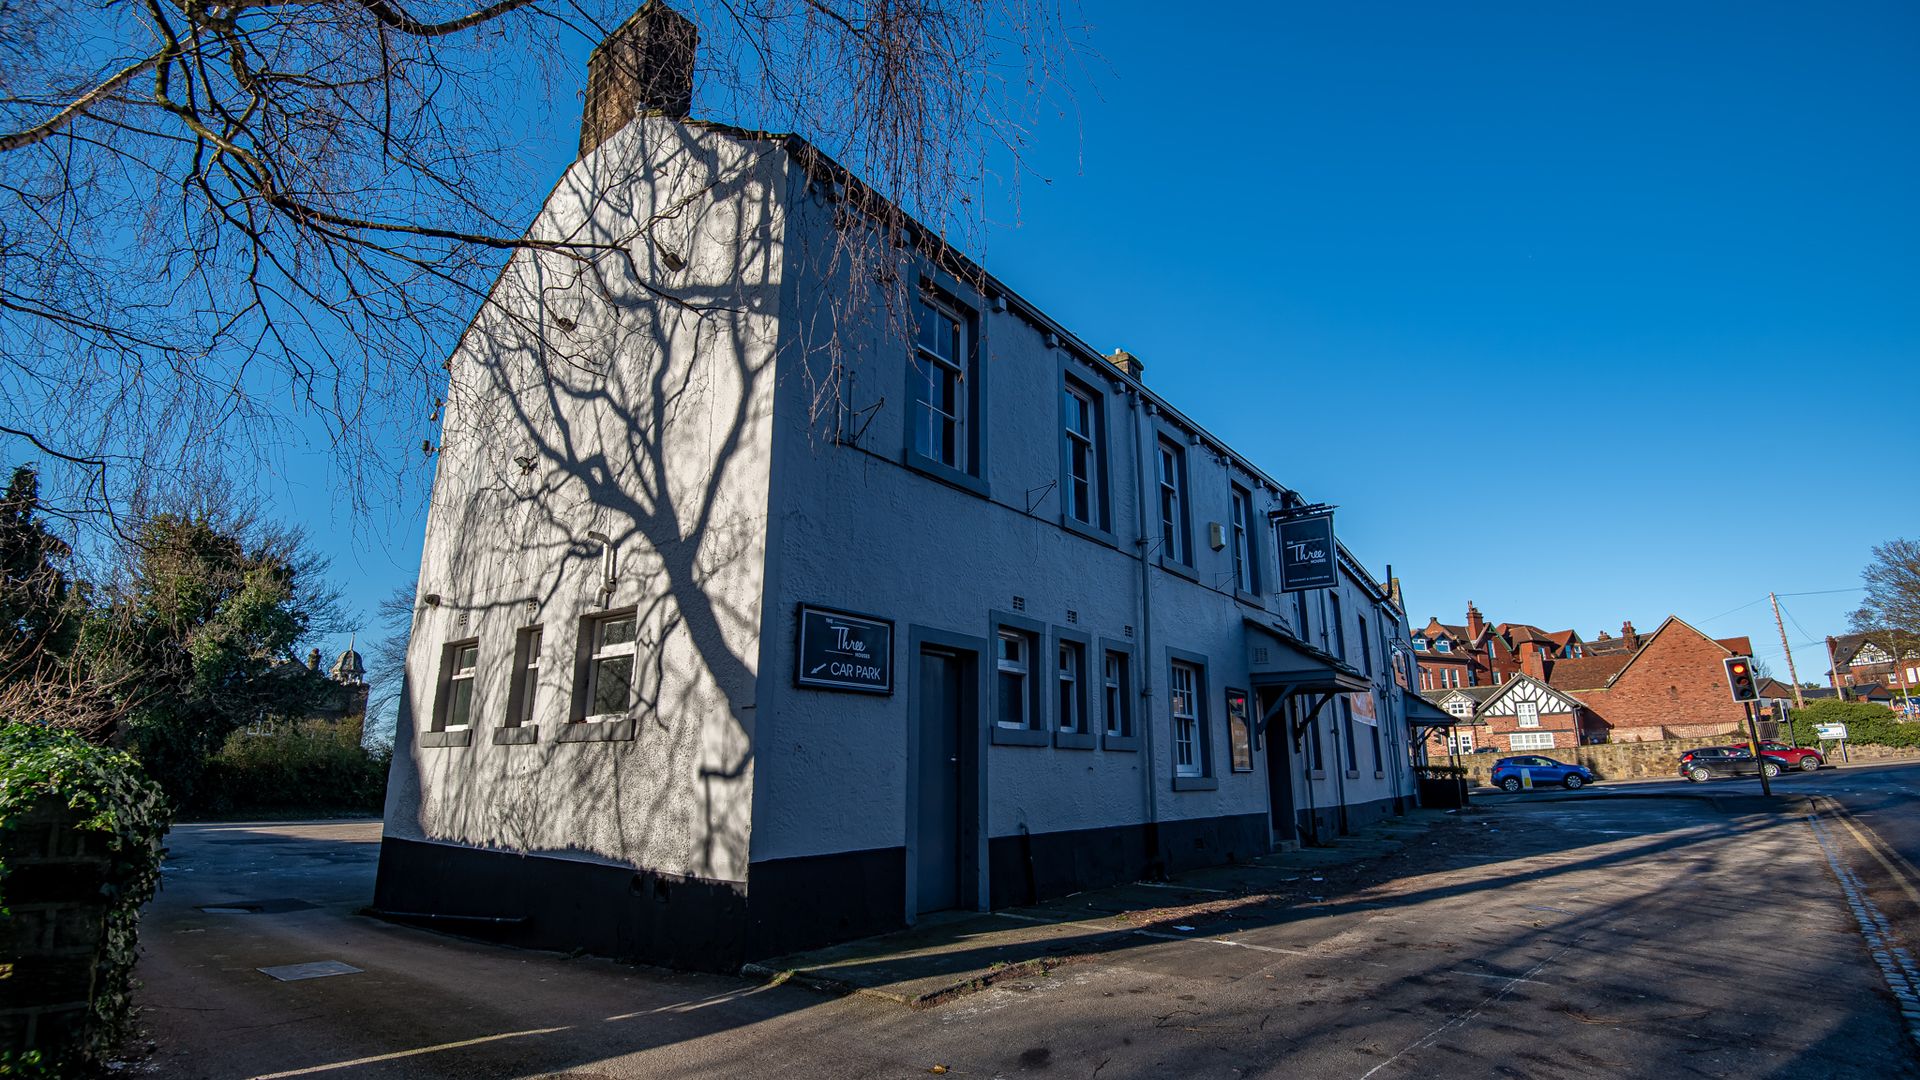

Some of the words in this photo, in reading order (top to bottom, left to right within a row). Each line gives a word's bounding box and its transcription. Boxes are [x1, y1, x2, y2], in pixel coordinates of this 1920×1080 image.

[1286, 543, 1325, 562] Three
[830, 626, 866, 651] Three
[830, 662, 853, 677] CAR
[856, 665, 880, 680] PARK
